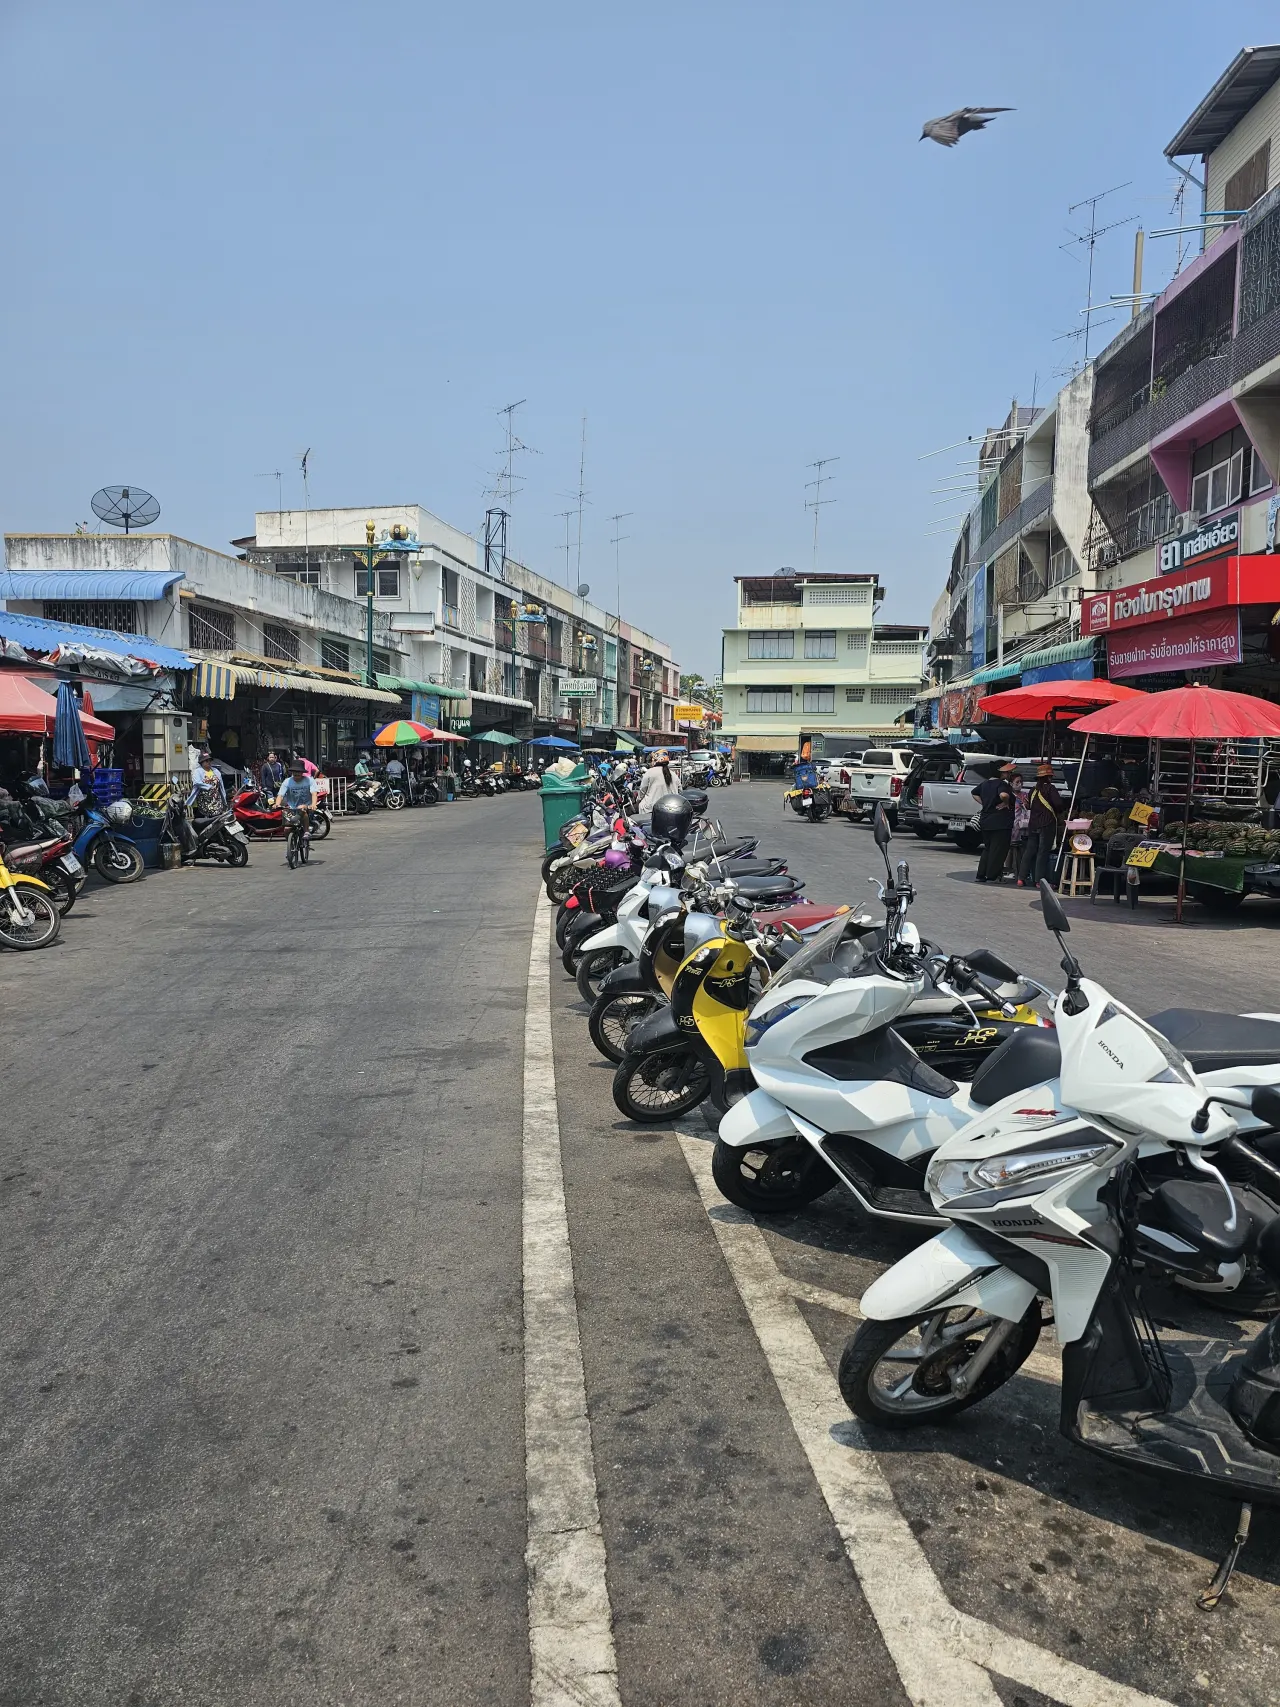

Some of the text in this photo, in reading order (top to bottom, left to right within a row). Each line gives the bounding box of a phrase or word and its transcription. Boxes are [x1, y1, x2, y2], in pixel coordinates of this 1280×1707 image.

[1160, 540, 1181, 571] ยา
[1114, 577, 1211, 621] ทองใบกรุงเทพ
[1098, 1040, 1124, 1070] HONDA
[991, 1218, 1044, 1227] HONDA
